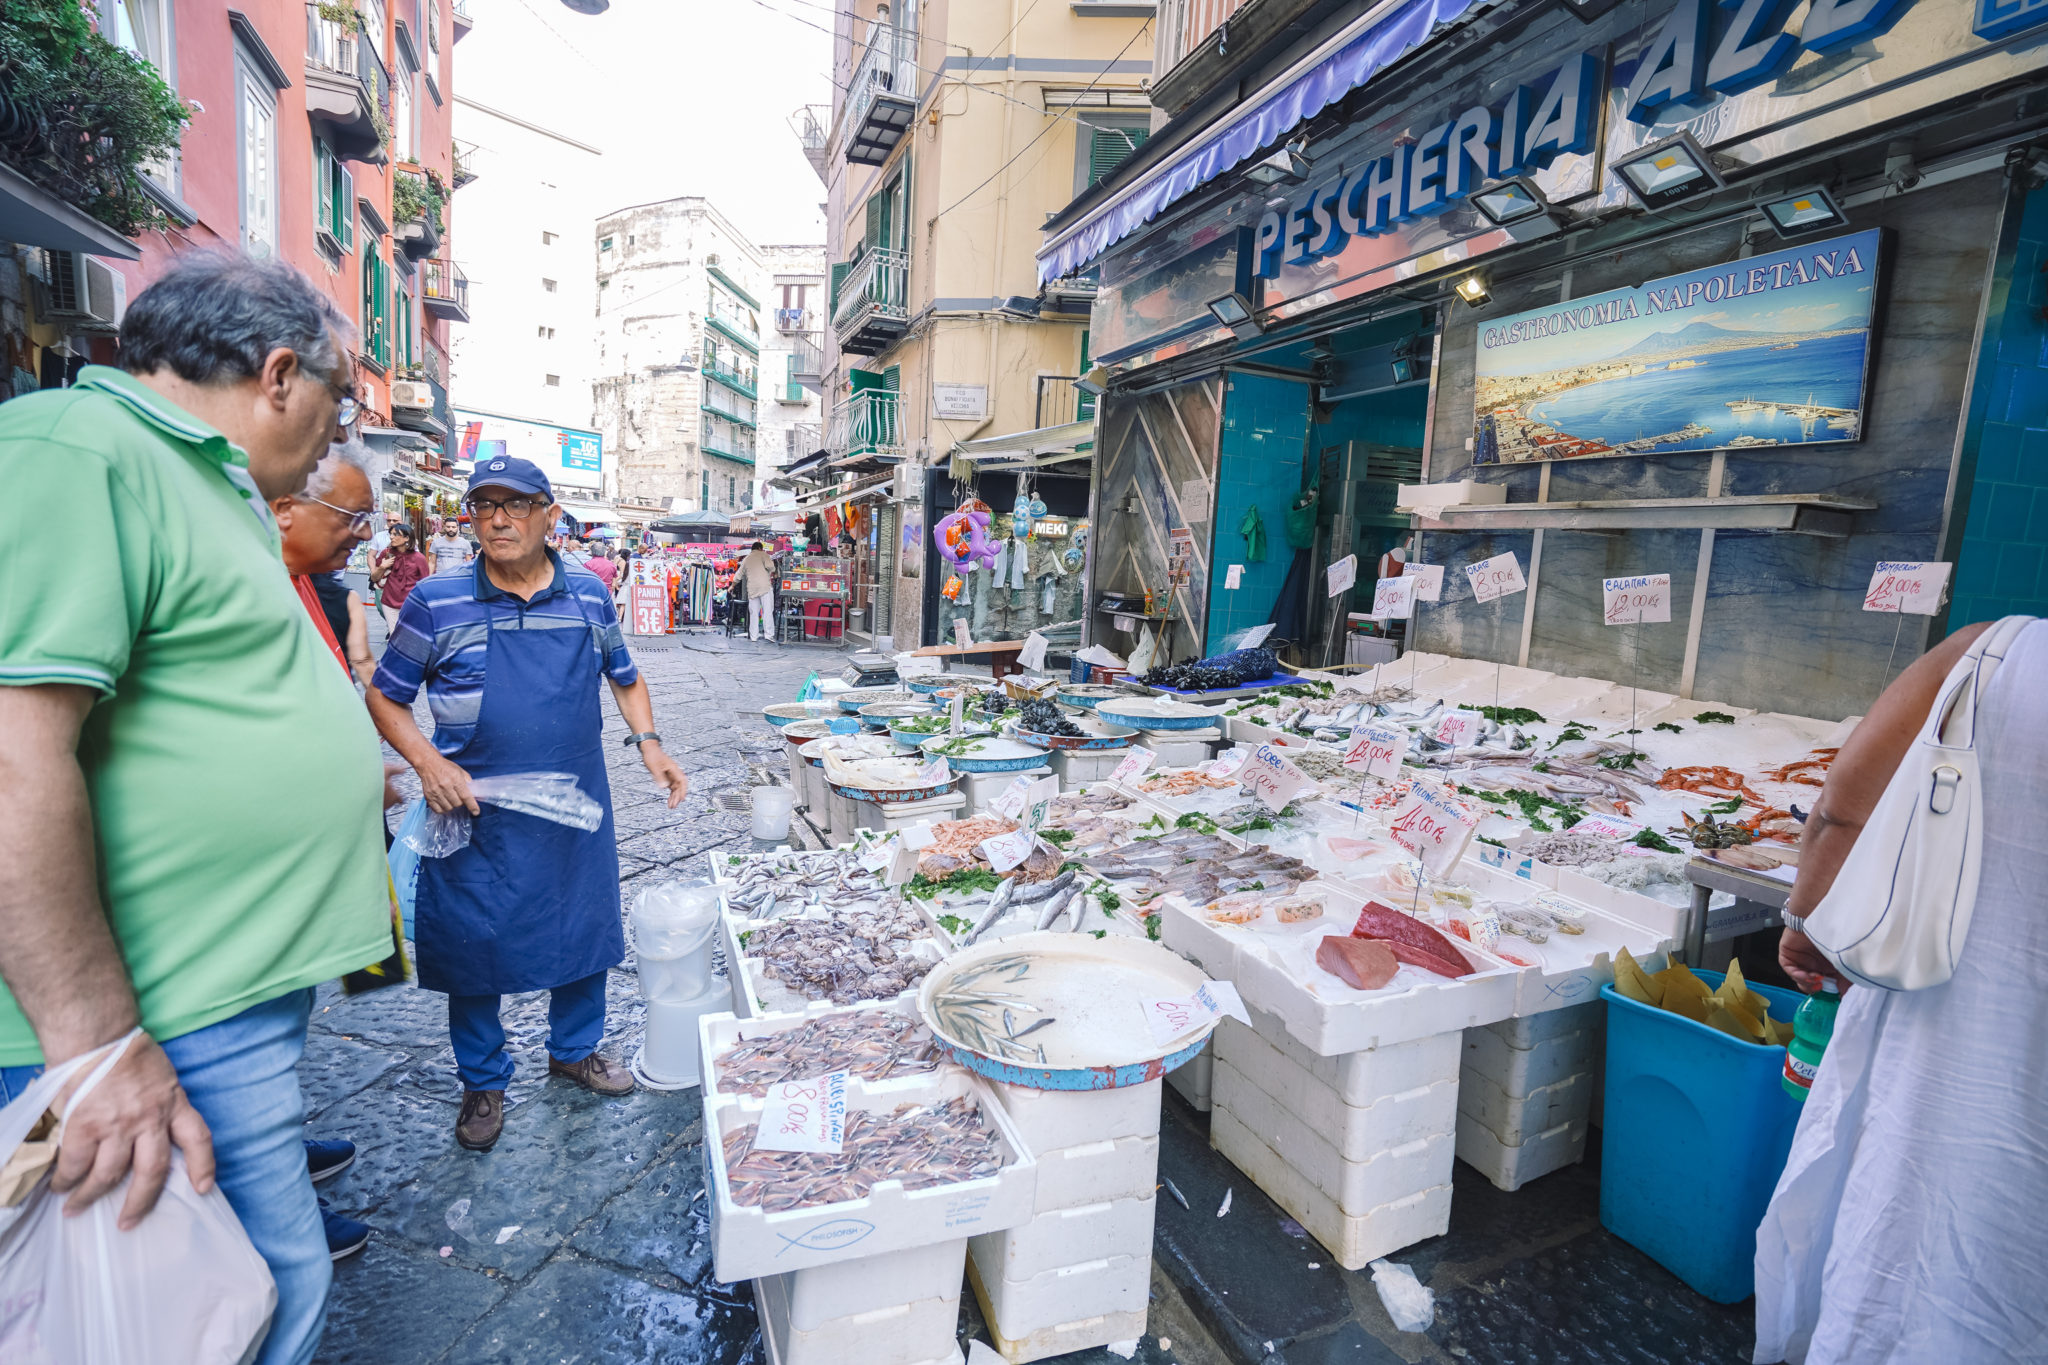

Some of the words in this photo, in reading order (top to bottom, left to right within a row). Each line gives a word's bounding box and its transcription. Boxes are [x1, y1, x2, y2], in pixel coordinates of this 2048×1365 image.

[1252, 52, 1594, 279] PESCHERIA
[1483, 295, 1639, 349] GASTRONOMIA
[1645, 246, 1864, 316] NAPOLETANA
[1035, 522, 1068, 535] MEKI
[1605, 577, 1651, 592] CALAMARI
[637, 587, 661, 598] PANINI
[637, 599, 661, 608] GOURMET
[638, 608, 662, 633] 3€
[810, 1227, 858, 1241] PHILOSOFISH
